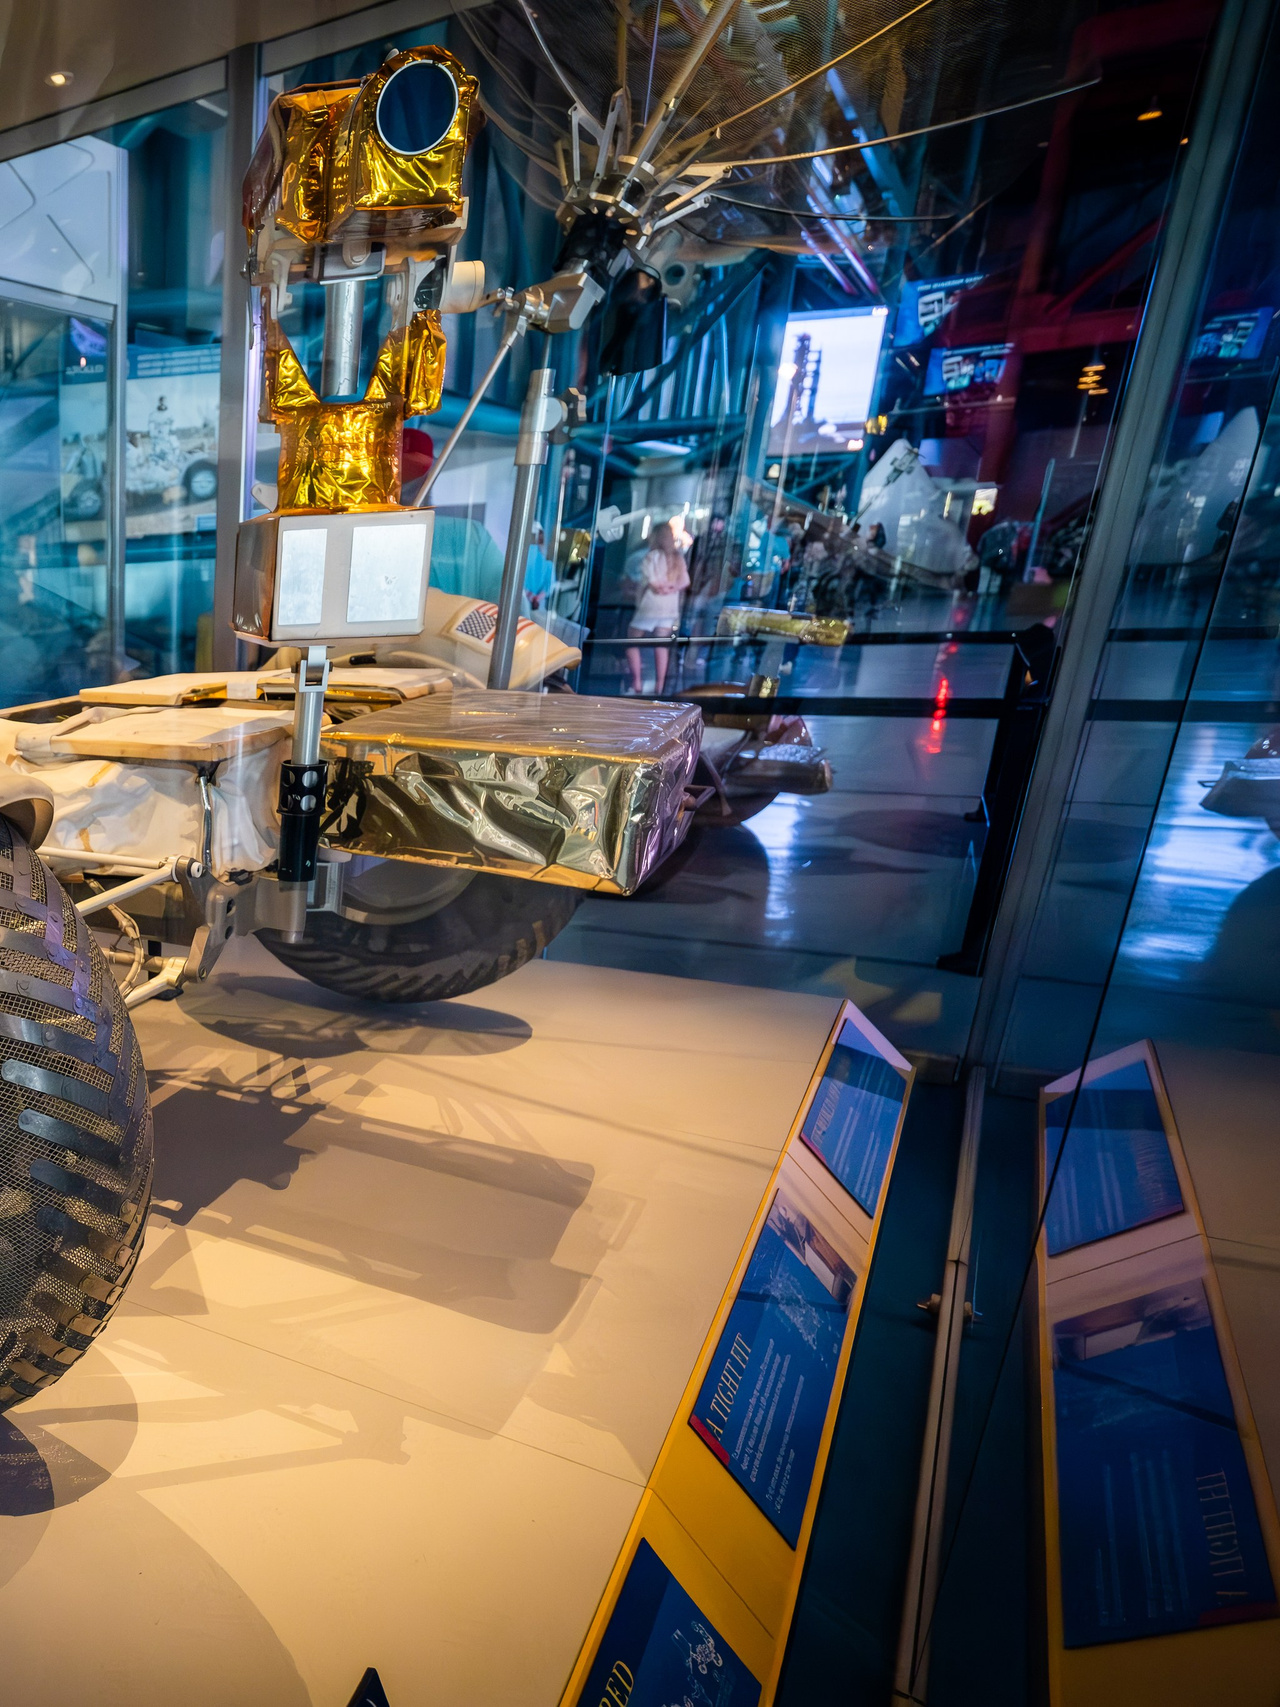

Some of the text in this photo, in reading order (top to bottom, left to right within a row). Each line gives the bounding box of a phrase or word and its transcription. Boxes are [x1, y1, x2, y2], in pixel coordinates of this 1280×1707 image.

[706, 1332, 752, 1441] A TIGHT FIT
